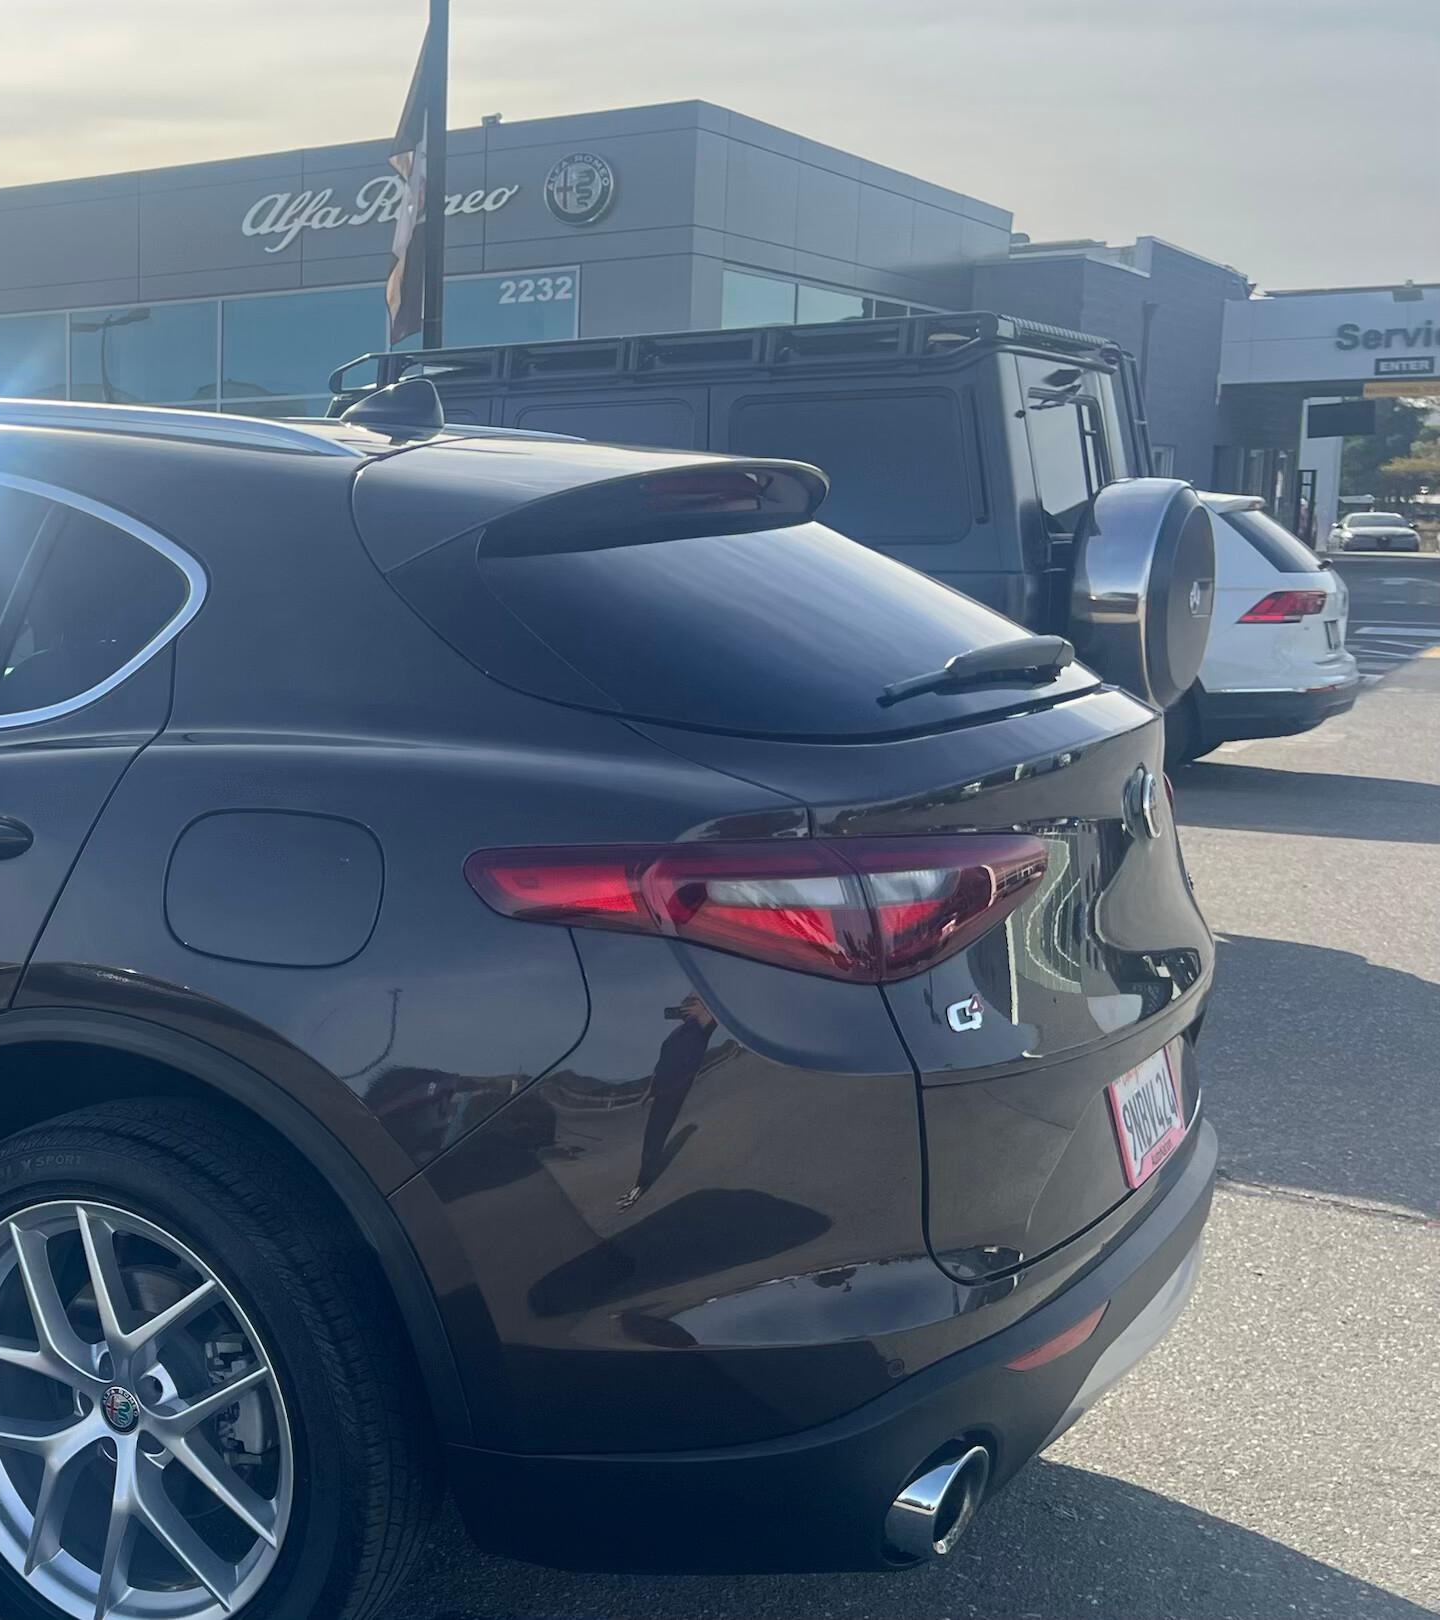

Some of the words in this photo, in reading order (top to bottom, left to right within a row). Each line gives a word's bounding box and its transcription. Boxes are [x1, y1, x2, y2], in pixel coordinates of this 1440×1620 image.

[242, 188, 349, 253] Alfa
[498, 276, 573, 304] 2232
[1380, 360, 1430, 373] ENTER
[946, 993, 985, 1032] Q4
[1122, 1068, 1178, 1161] 9NBV424
[35, 1154, 81, 1167] SPORT
